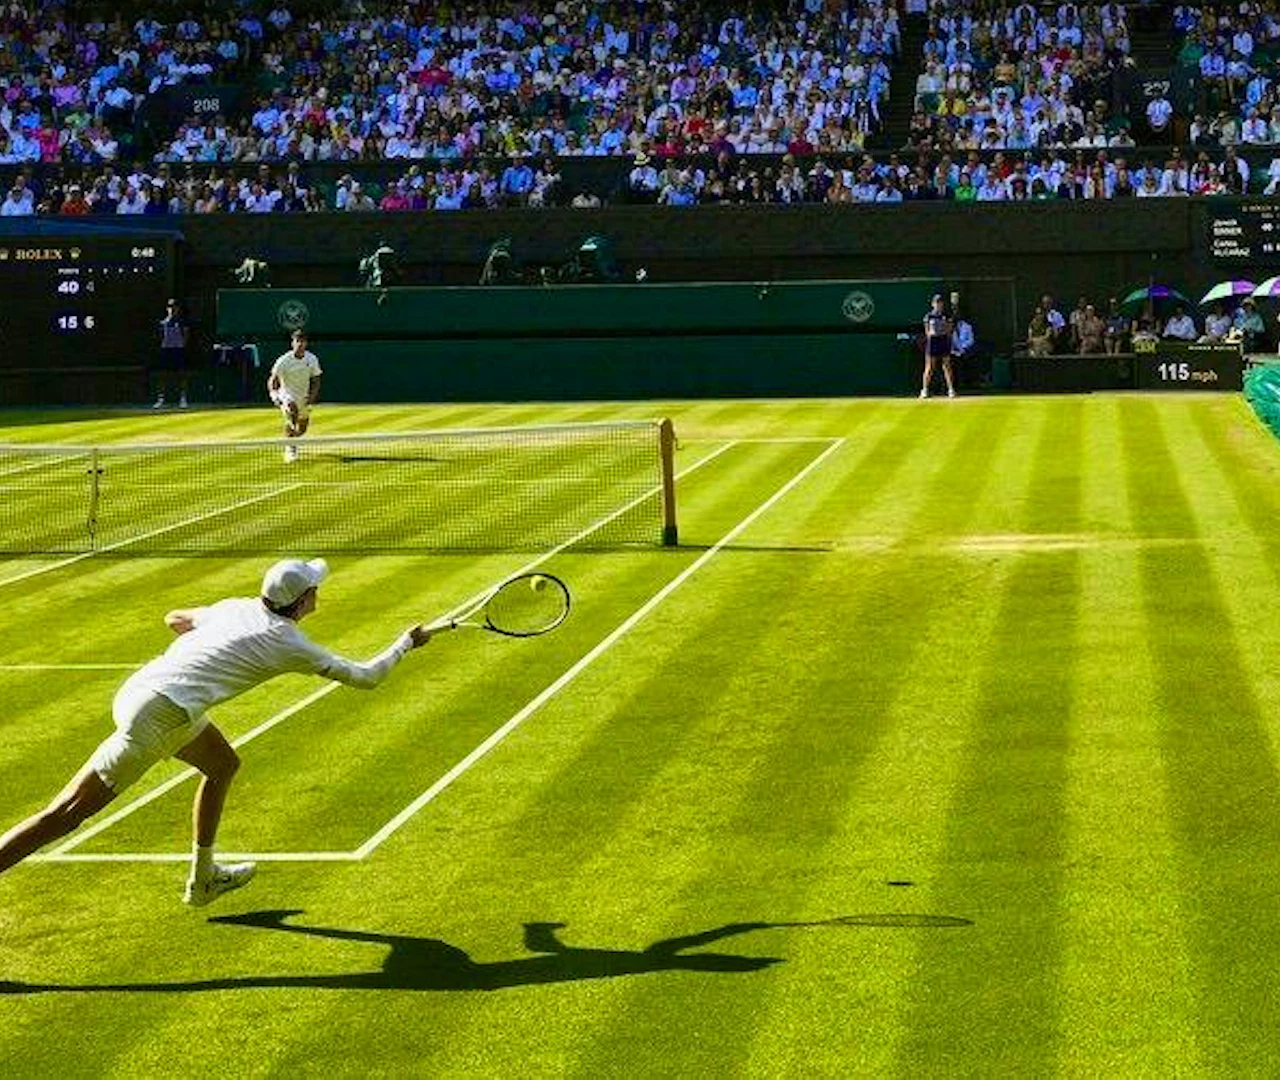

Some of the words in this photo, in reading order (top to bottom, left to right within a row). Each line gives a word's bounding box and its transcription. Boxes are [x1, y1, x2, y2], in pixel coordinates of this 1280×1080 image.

[15, 249, 63, 261] ROLEX
[57, 281, 80, 294] 40
[58, 316, 78, 329] 15
[1157, 362, 1190, 382] 115
[1190, 369, 1219, 384] mph
